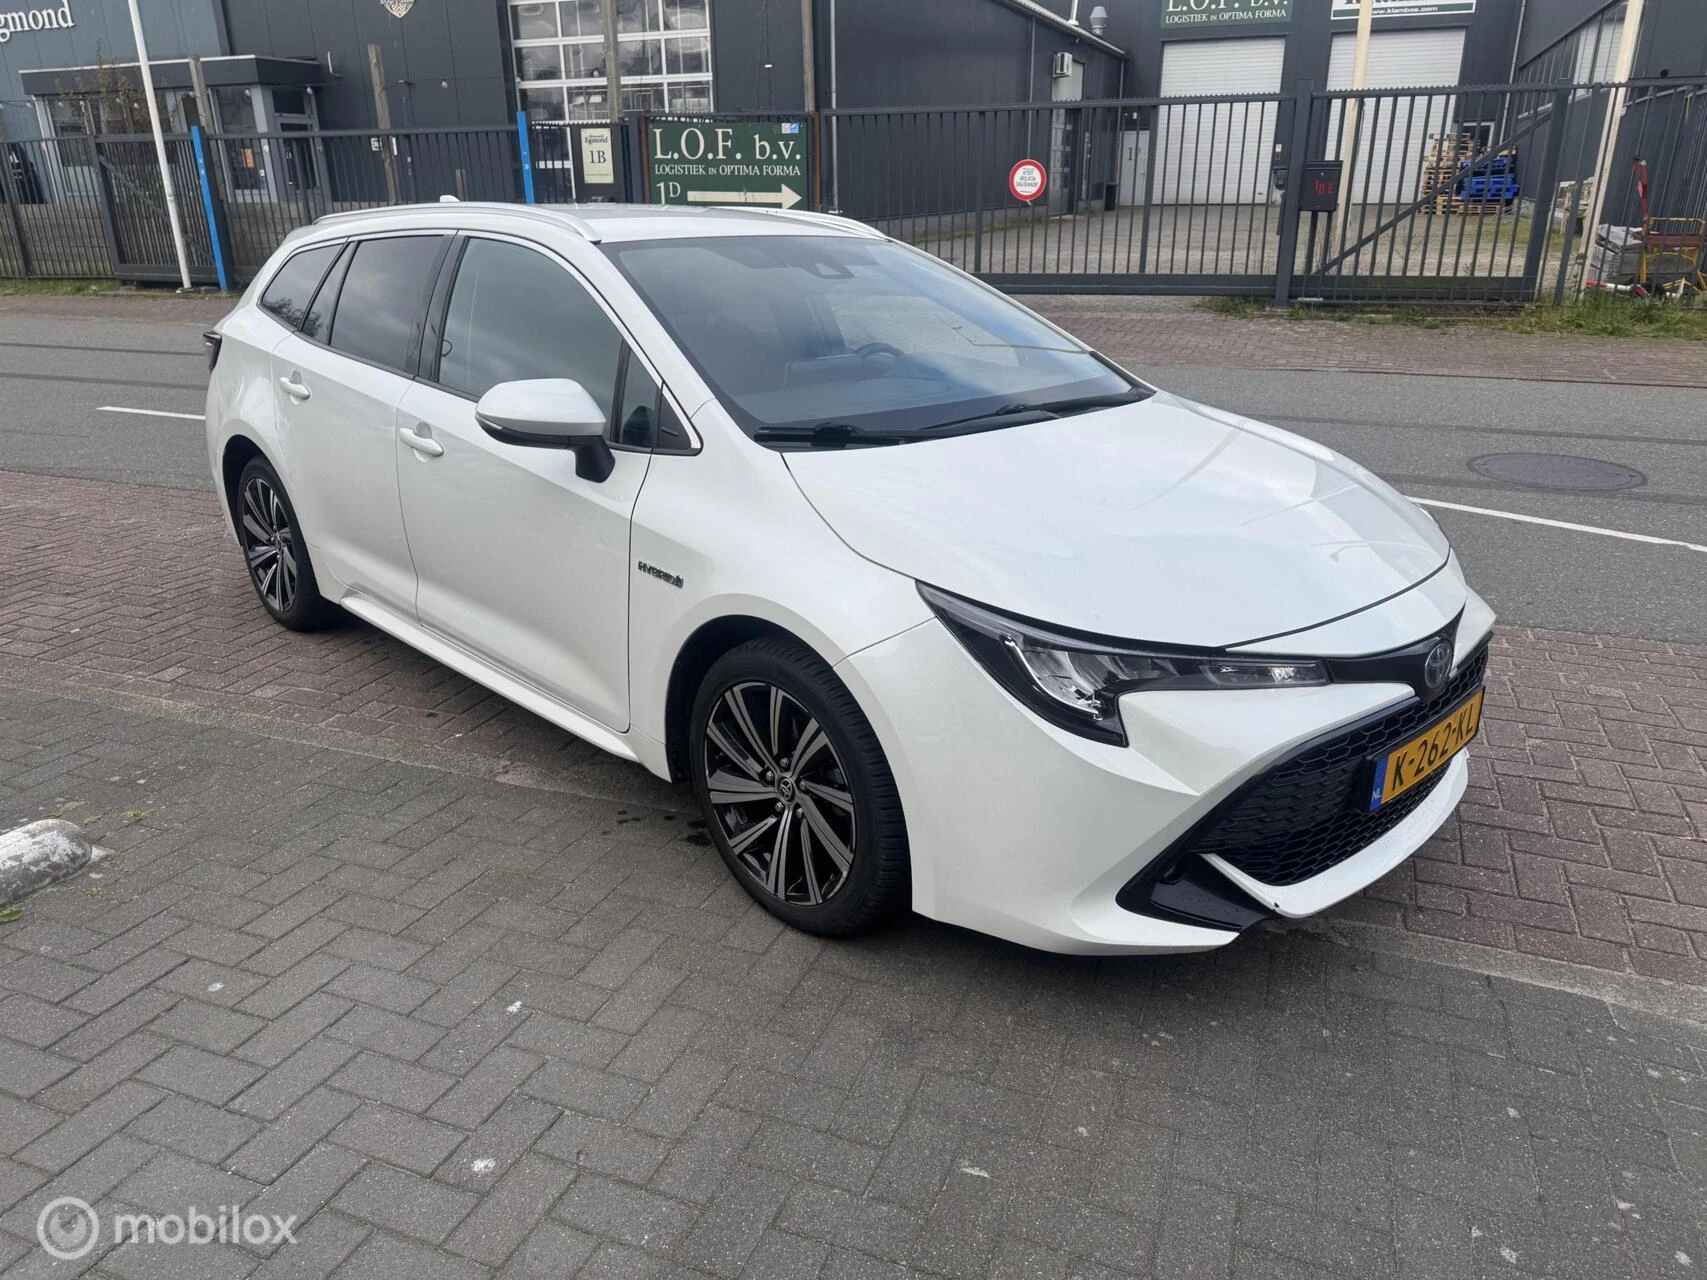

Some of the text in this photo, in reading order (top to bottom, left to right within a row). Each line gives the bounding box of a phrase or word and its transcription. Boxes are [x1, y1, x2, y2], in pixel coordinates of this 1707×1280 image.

[1165, 14, 1208, 24] LOGISTIEK
[1219, 11, 1252, 20] OPTIMA
[1255, 9, 1286, 18] FORMA
[1372, 6, 1438, 14] ww.klamboe.com
[653, 127, 801, 160] L.O.F. b.v.
[589, 150, 606, 164] 1B
[655, 164, 706, 175] LOGISTIEK
[719, 164, 760, 175] OPTIMA
[763, 165, 801, 176] FORMA
[656, 181, 681, 205] 1D
[1392, 703, 1474, 791] K-262-KL
[1371, 788, 1381, 801] NL
